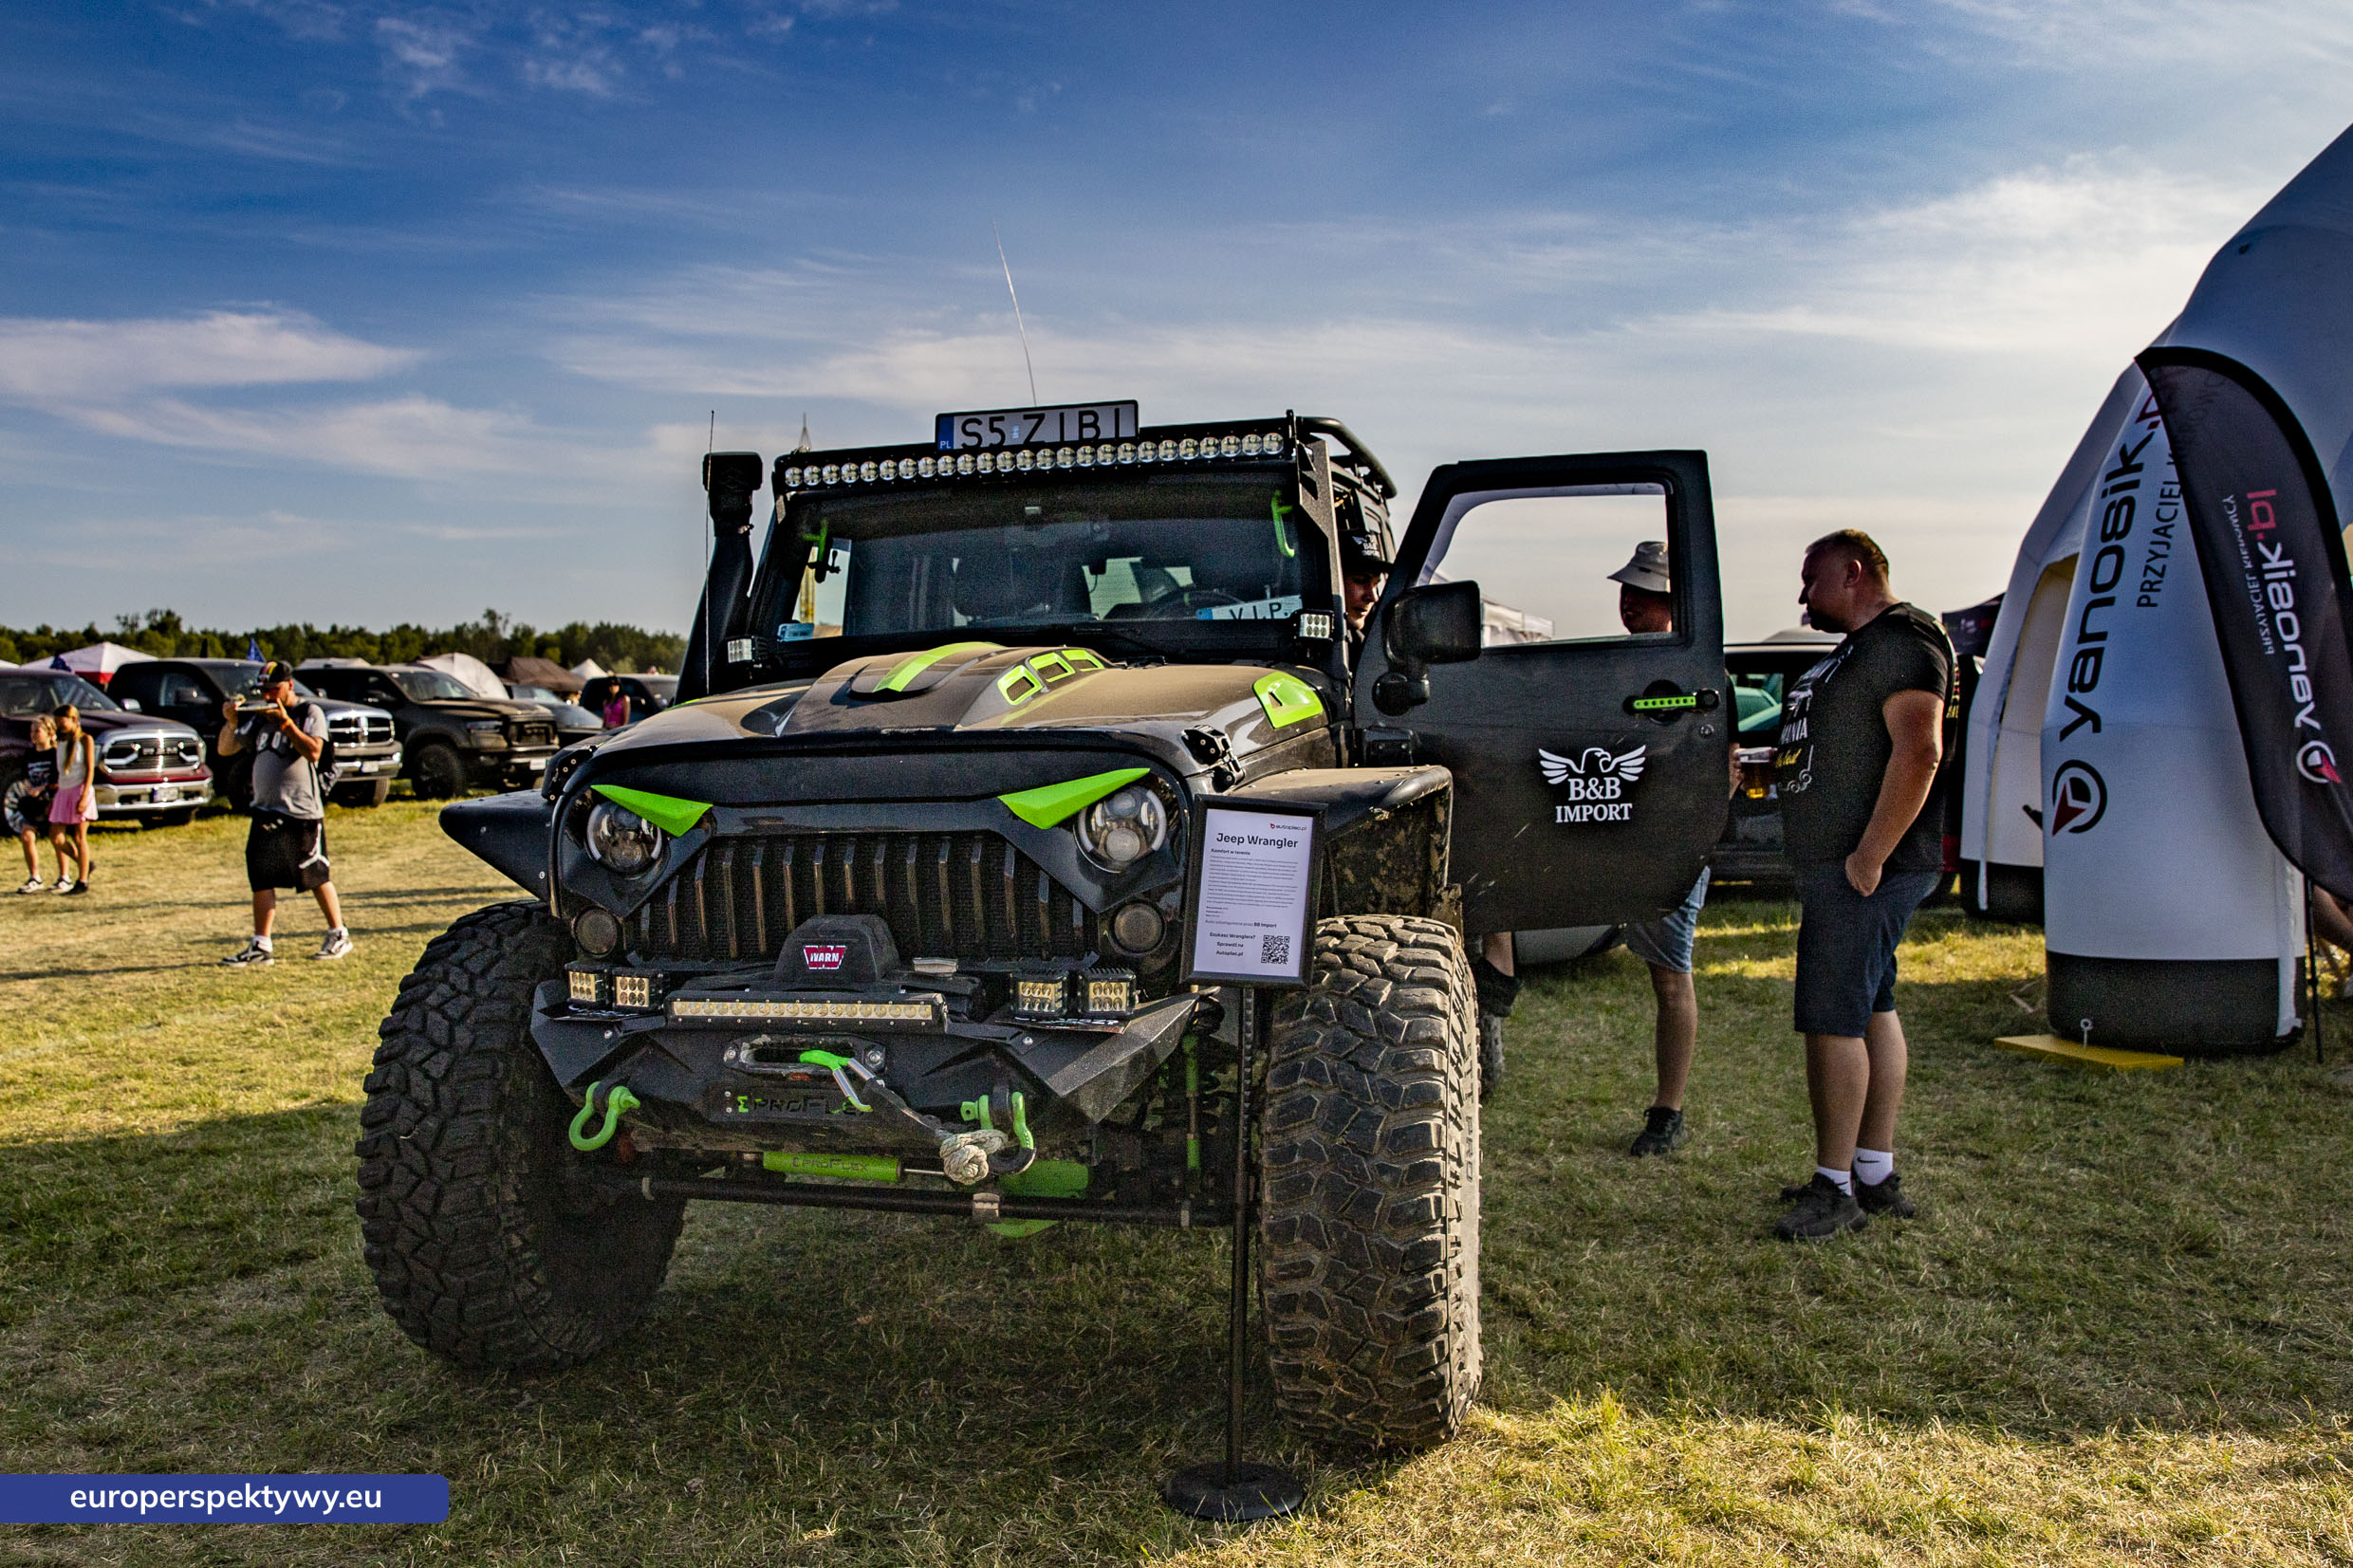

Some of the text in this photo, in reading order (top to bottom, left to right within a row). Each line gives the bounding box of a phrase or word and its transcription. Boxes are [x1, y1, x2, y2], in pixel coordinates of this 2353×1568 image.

[1022, 407, 1121, 444] ZIBI
[939, 439, 952, 449] PL
[1566, 777, 1621, 802] B&B
[1555, 802, 1633, 823] IMPORT
[1215, 832, 1299, 849] Jeep Wrangler
[809, 952, 840, 963] WARN
